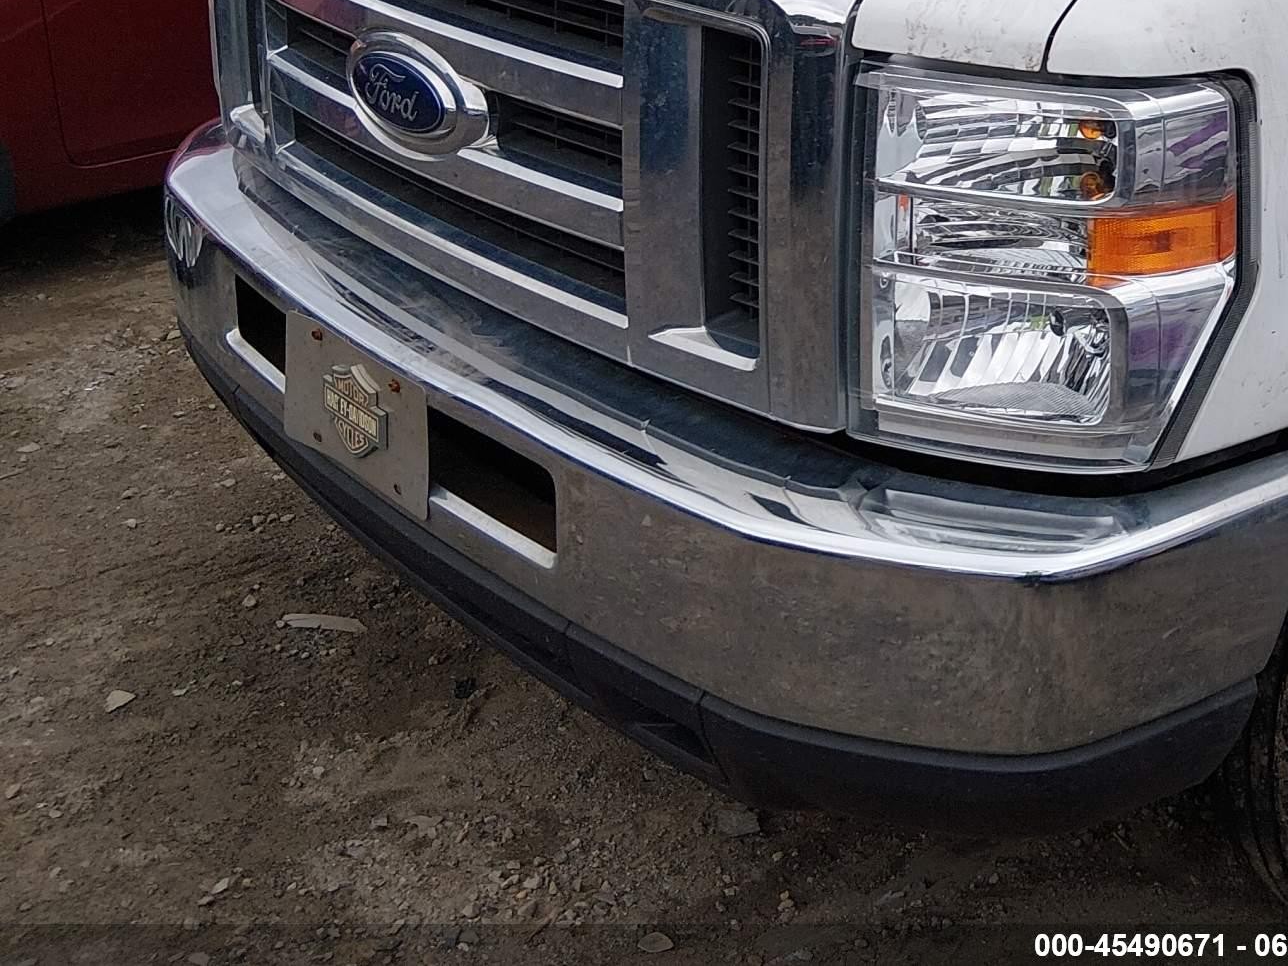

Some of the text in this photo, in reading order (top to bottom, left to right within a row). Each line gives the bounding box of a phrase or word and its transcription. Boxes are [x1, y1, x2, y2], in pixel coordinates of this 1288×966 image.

[364, 63, 419, 122] Ford
[326, 387, 377, 436] HAREY-DAVIDSON
[336, 377, 367, 407] MOTOR
[338, 420, 366, 446] CYCLES
